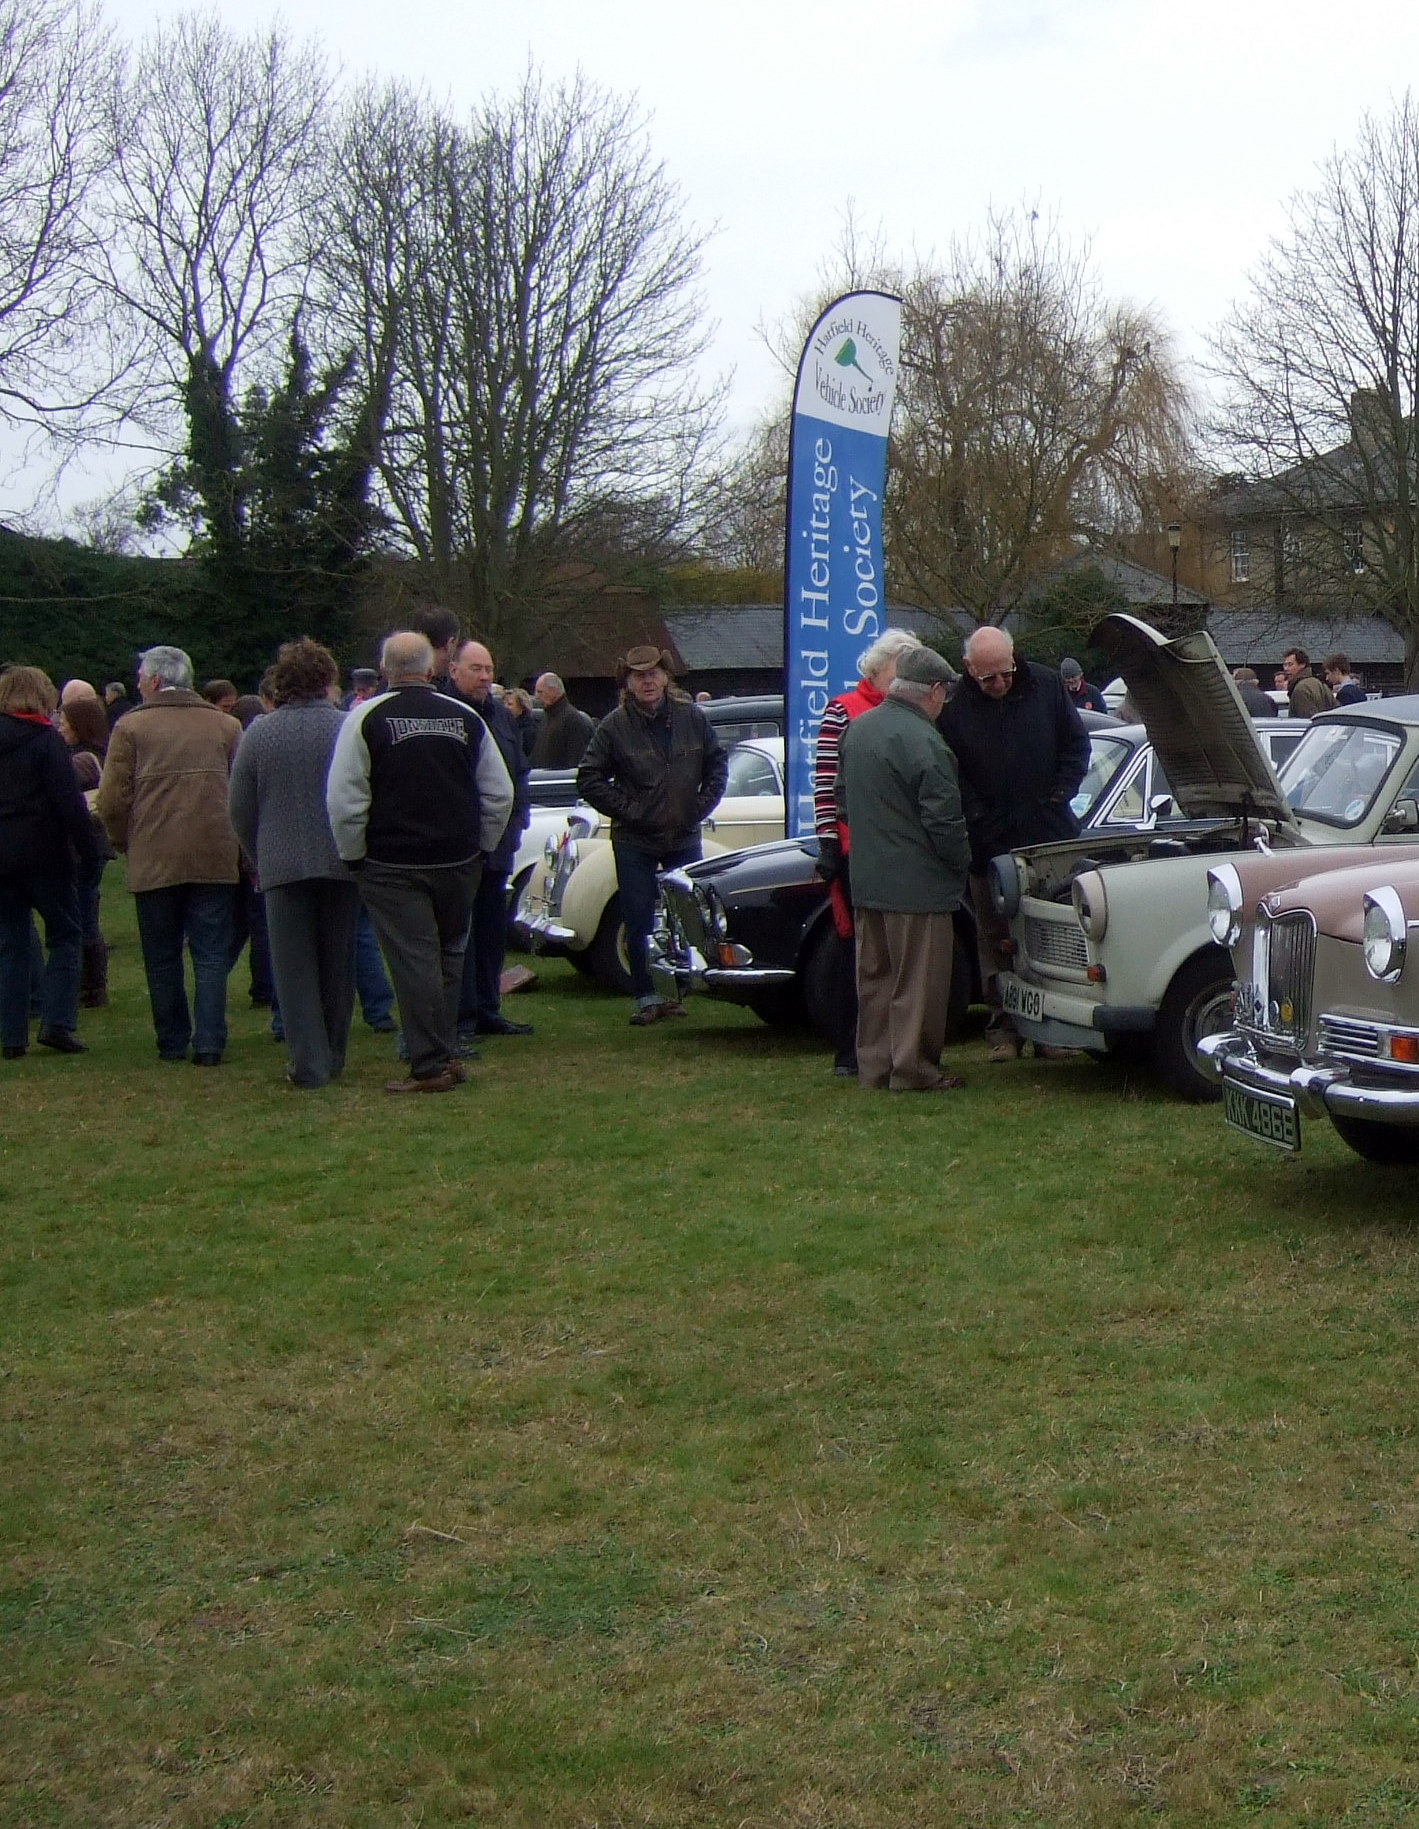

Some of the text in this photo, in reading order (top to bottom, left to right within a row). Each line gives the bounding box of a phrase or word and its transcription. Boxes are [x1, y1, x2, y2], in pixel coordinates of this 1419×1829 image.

[814, 319, 894, 376] Hatfield Heritage
[815, 358, 887, 417] Vehicle Society
[801, 437, 838, 631] Heritage
[843, 475, 880, 638] Society
[1021, 988, 1040, 1016] WGO
